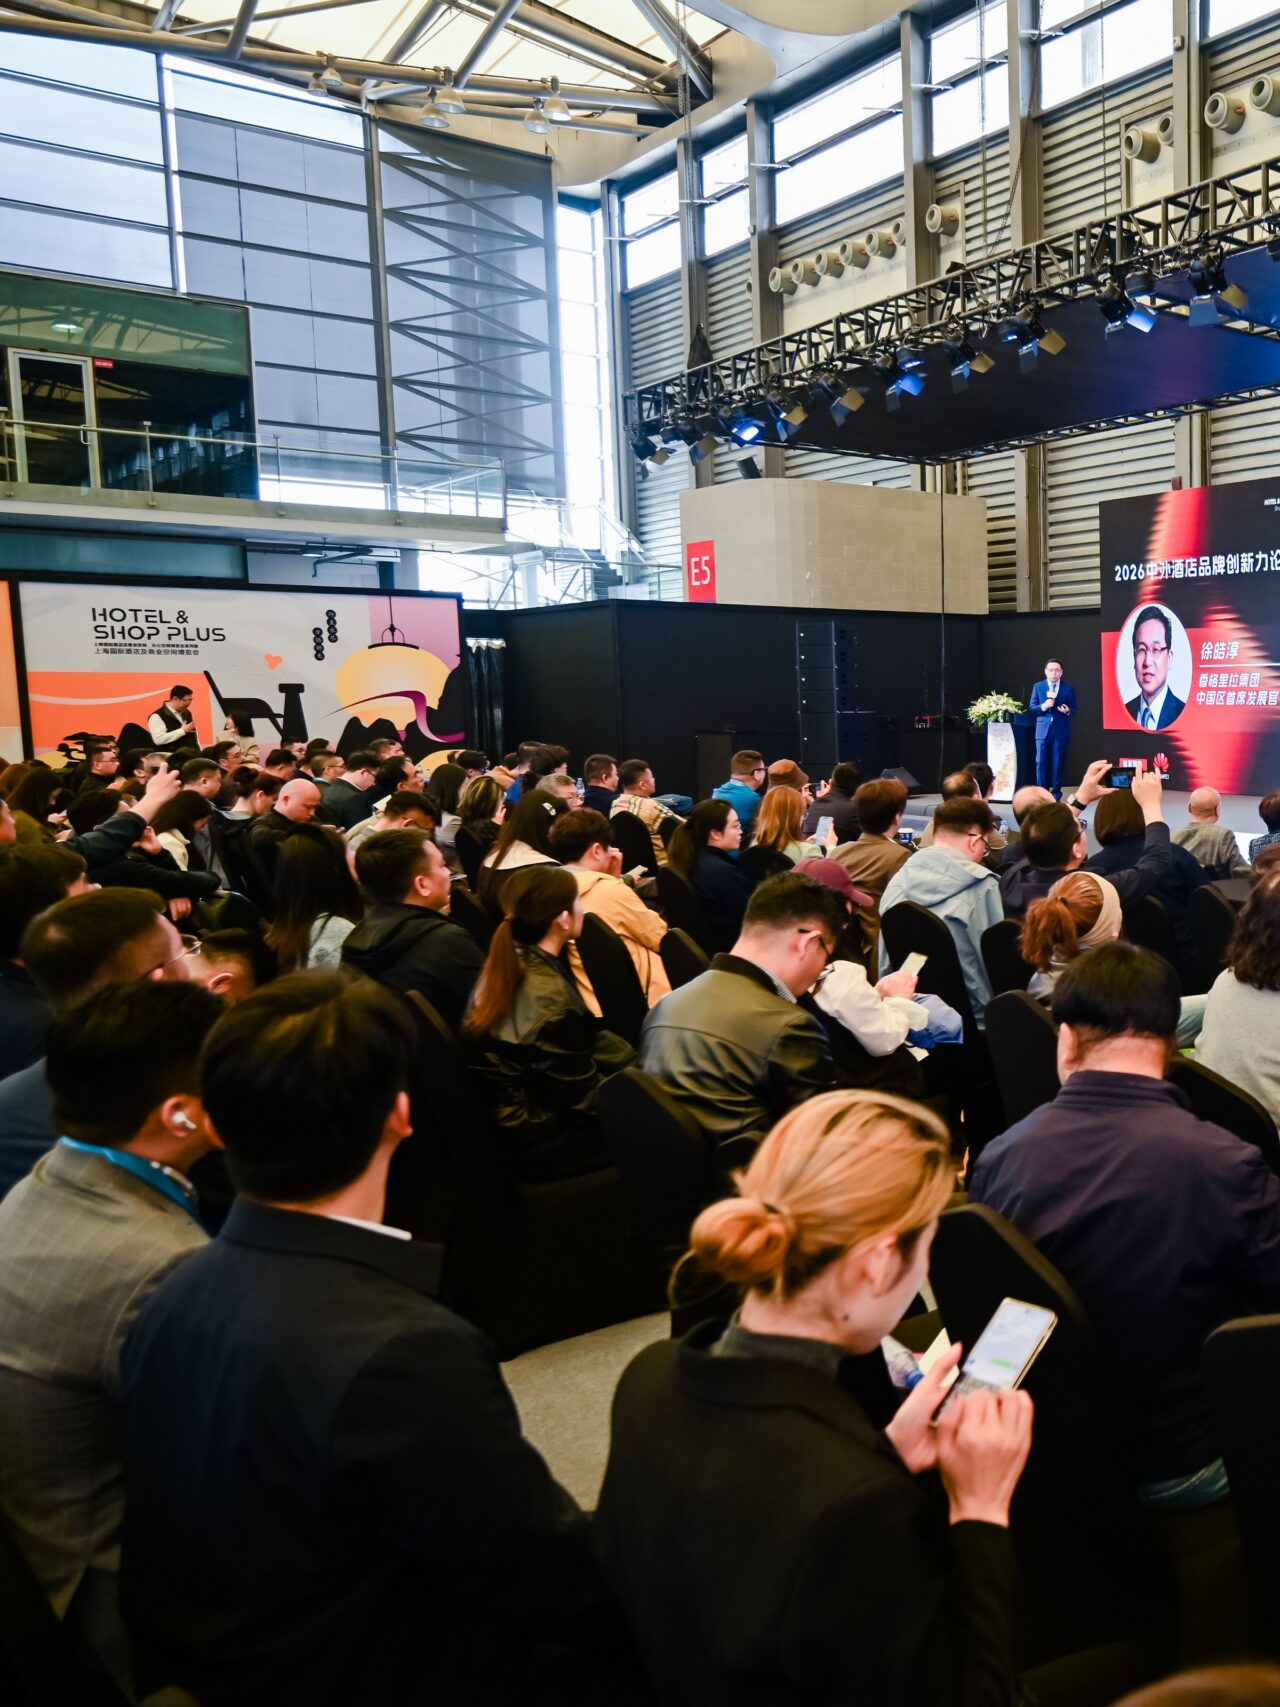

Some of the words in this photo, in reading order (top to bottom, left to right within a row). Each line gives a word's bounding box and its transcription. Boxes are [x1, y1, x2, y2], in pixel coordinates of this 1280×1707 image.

[691, 555, 711, 586] E5
[92, 607, 171, 624] HOTEL
[176, 610, 189, 624] &
[93, 625, 160, 640] SHOP
[167, 627, 226, 641] PLUS
[1201, 641, 1240, 660] 徐皓淳
[1198, 673, 1260, 688] 香格里拉集团
[1196, 691, 1279, 706] 中国区首席发展官
